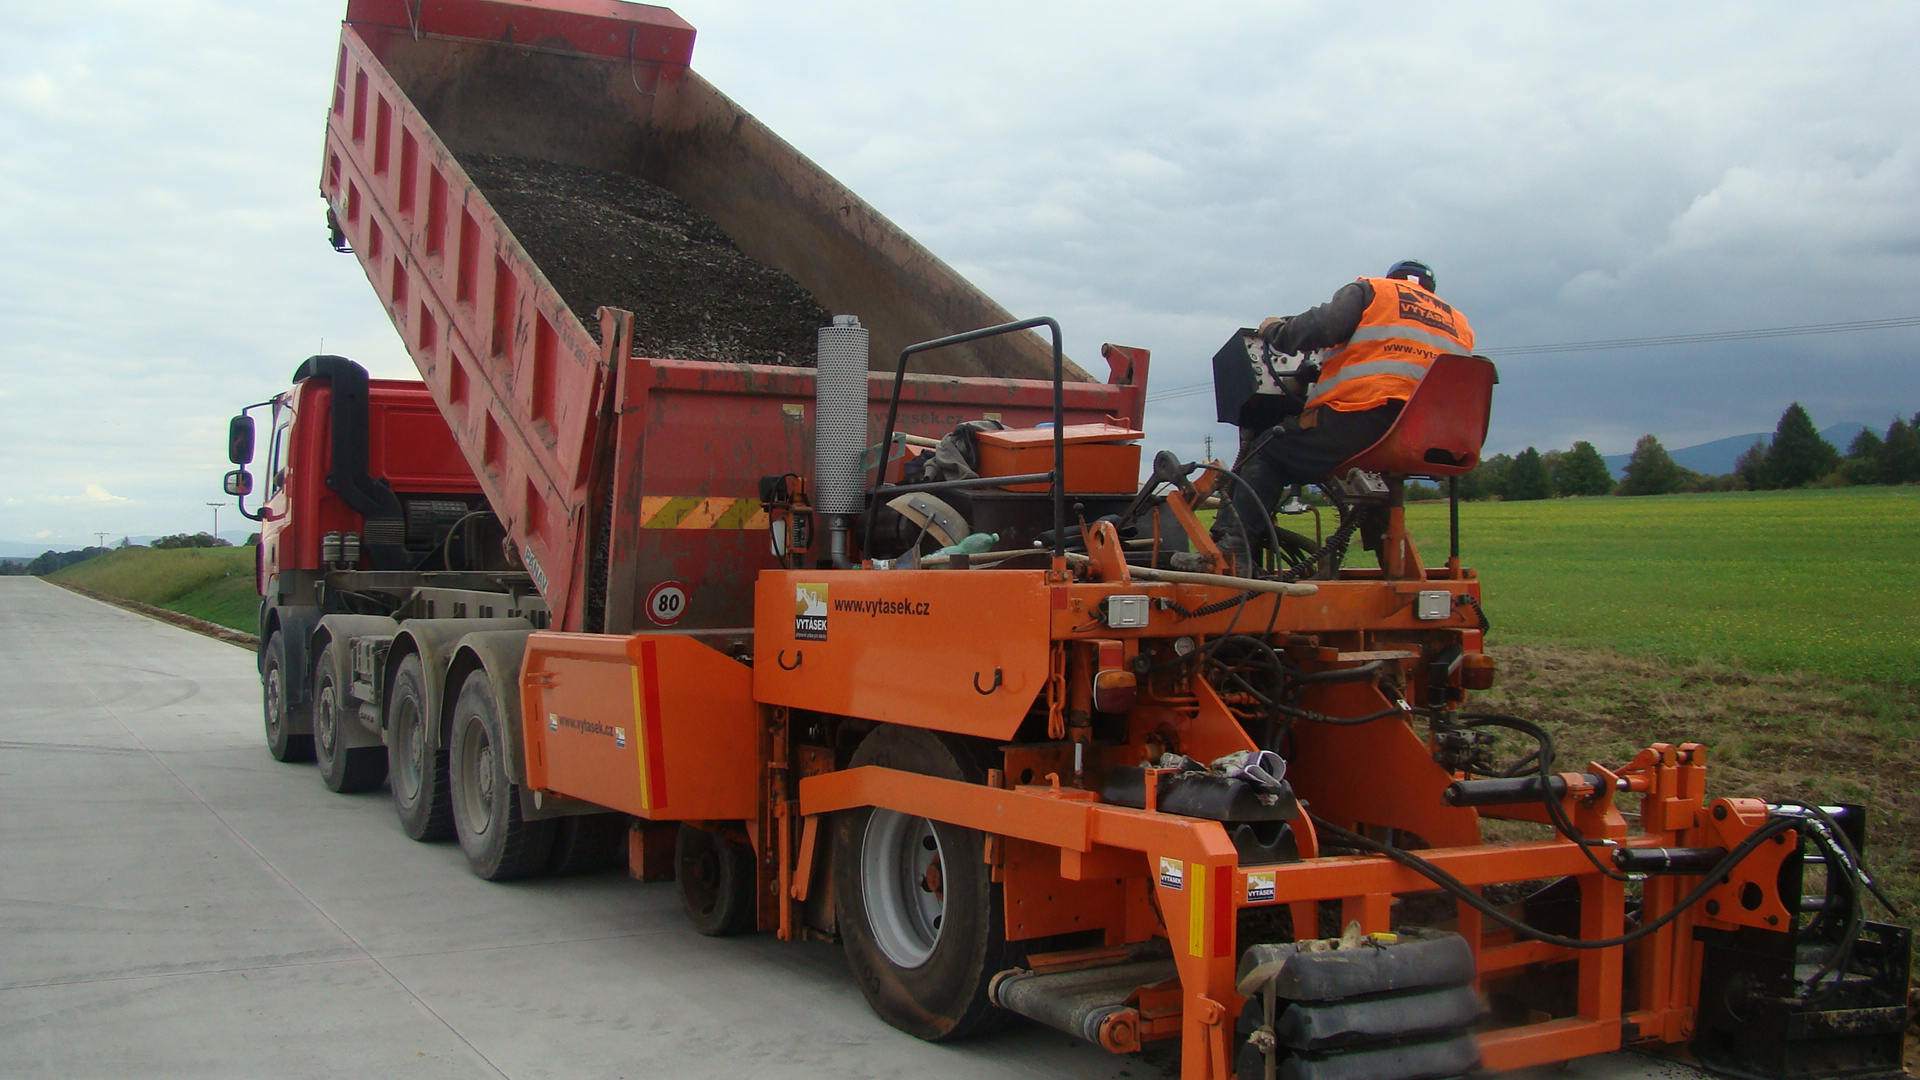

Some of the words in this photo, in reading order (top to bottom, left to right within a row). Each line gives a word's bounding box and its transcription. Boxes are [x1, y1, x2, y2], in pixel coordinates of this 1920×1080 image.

[658, 594, 680, 612] 80
[834, 598, 930, 618] www.vytasek.cz
[795, 616, 828, 631] VYTÁSEK
[558, 715, 614, 737] www.vytasek.cz
